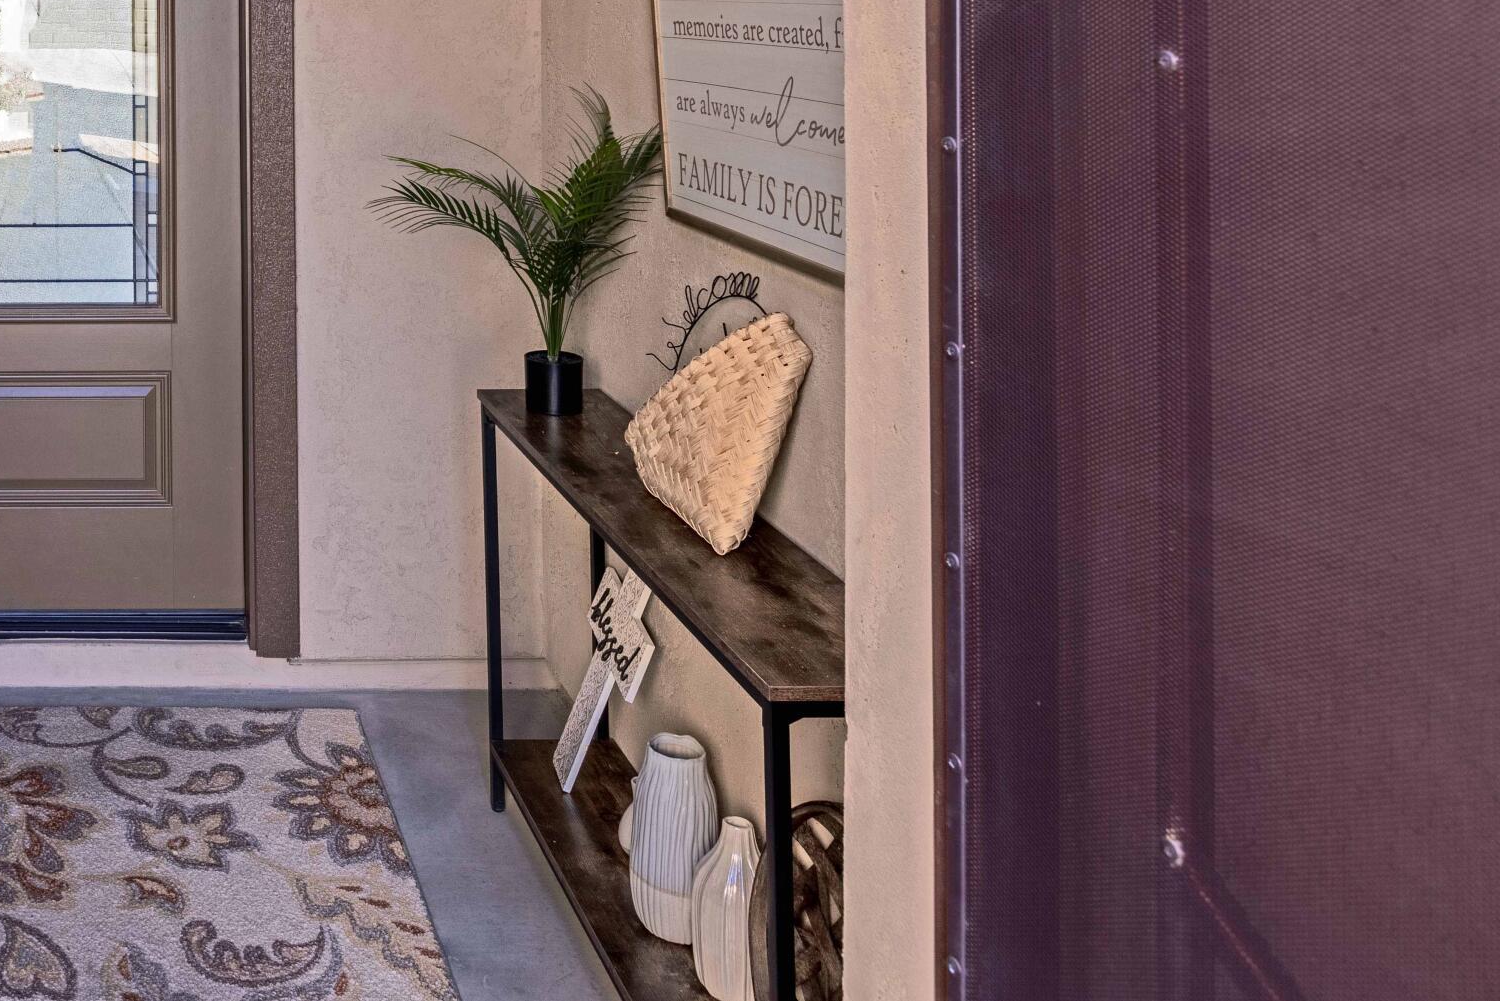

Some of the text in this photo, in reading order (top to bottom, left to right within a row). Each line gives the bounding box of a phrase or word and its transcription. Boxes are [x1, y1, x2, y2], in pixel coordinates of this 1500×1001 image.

[673, 14, 738, 41] memories
[742, 23, 765, 42] are
[768, 16, 829, 54] created,
[676, 76, 845, 147] are always welcome
[678, 152, 752, 207] FAMILY
[757, 174, 776, 215] IS
[591, 587, 641, 681] blessed
